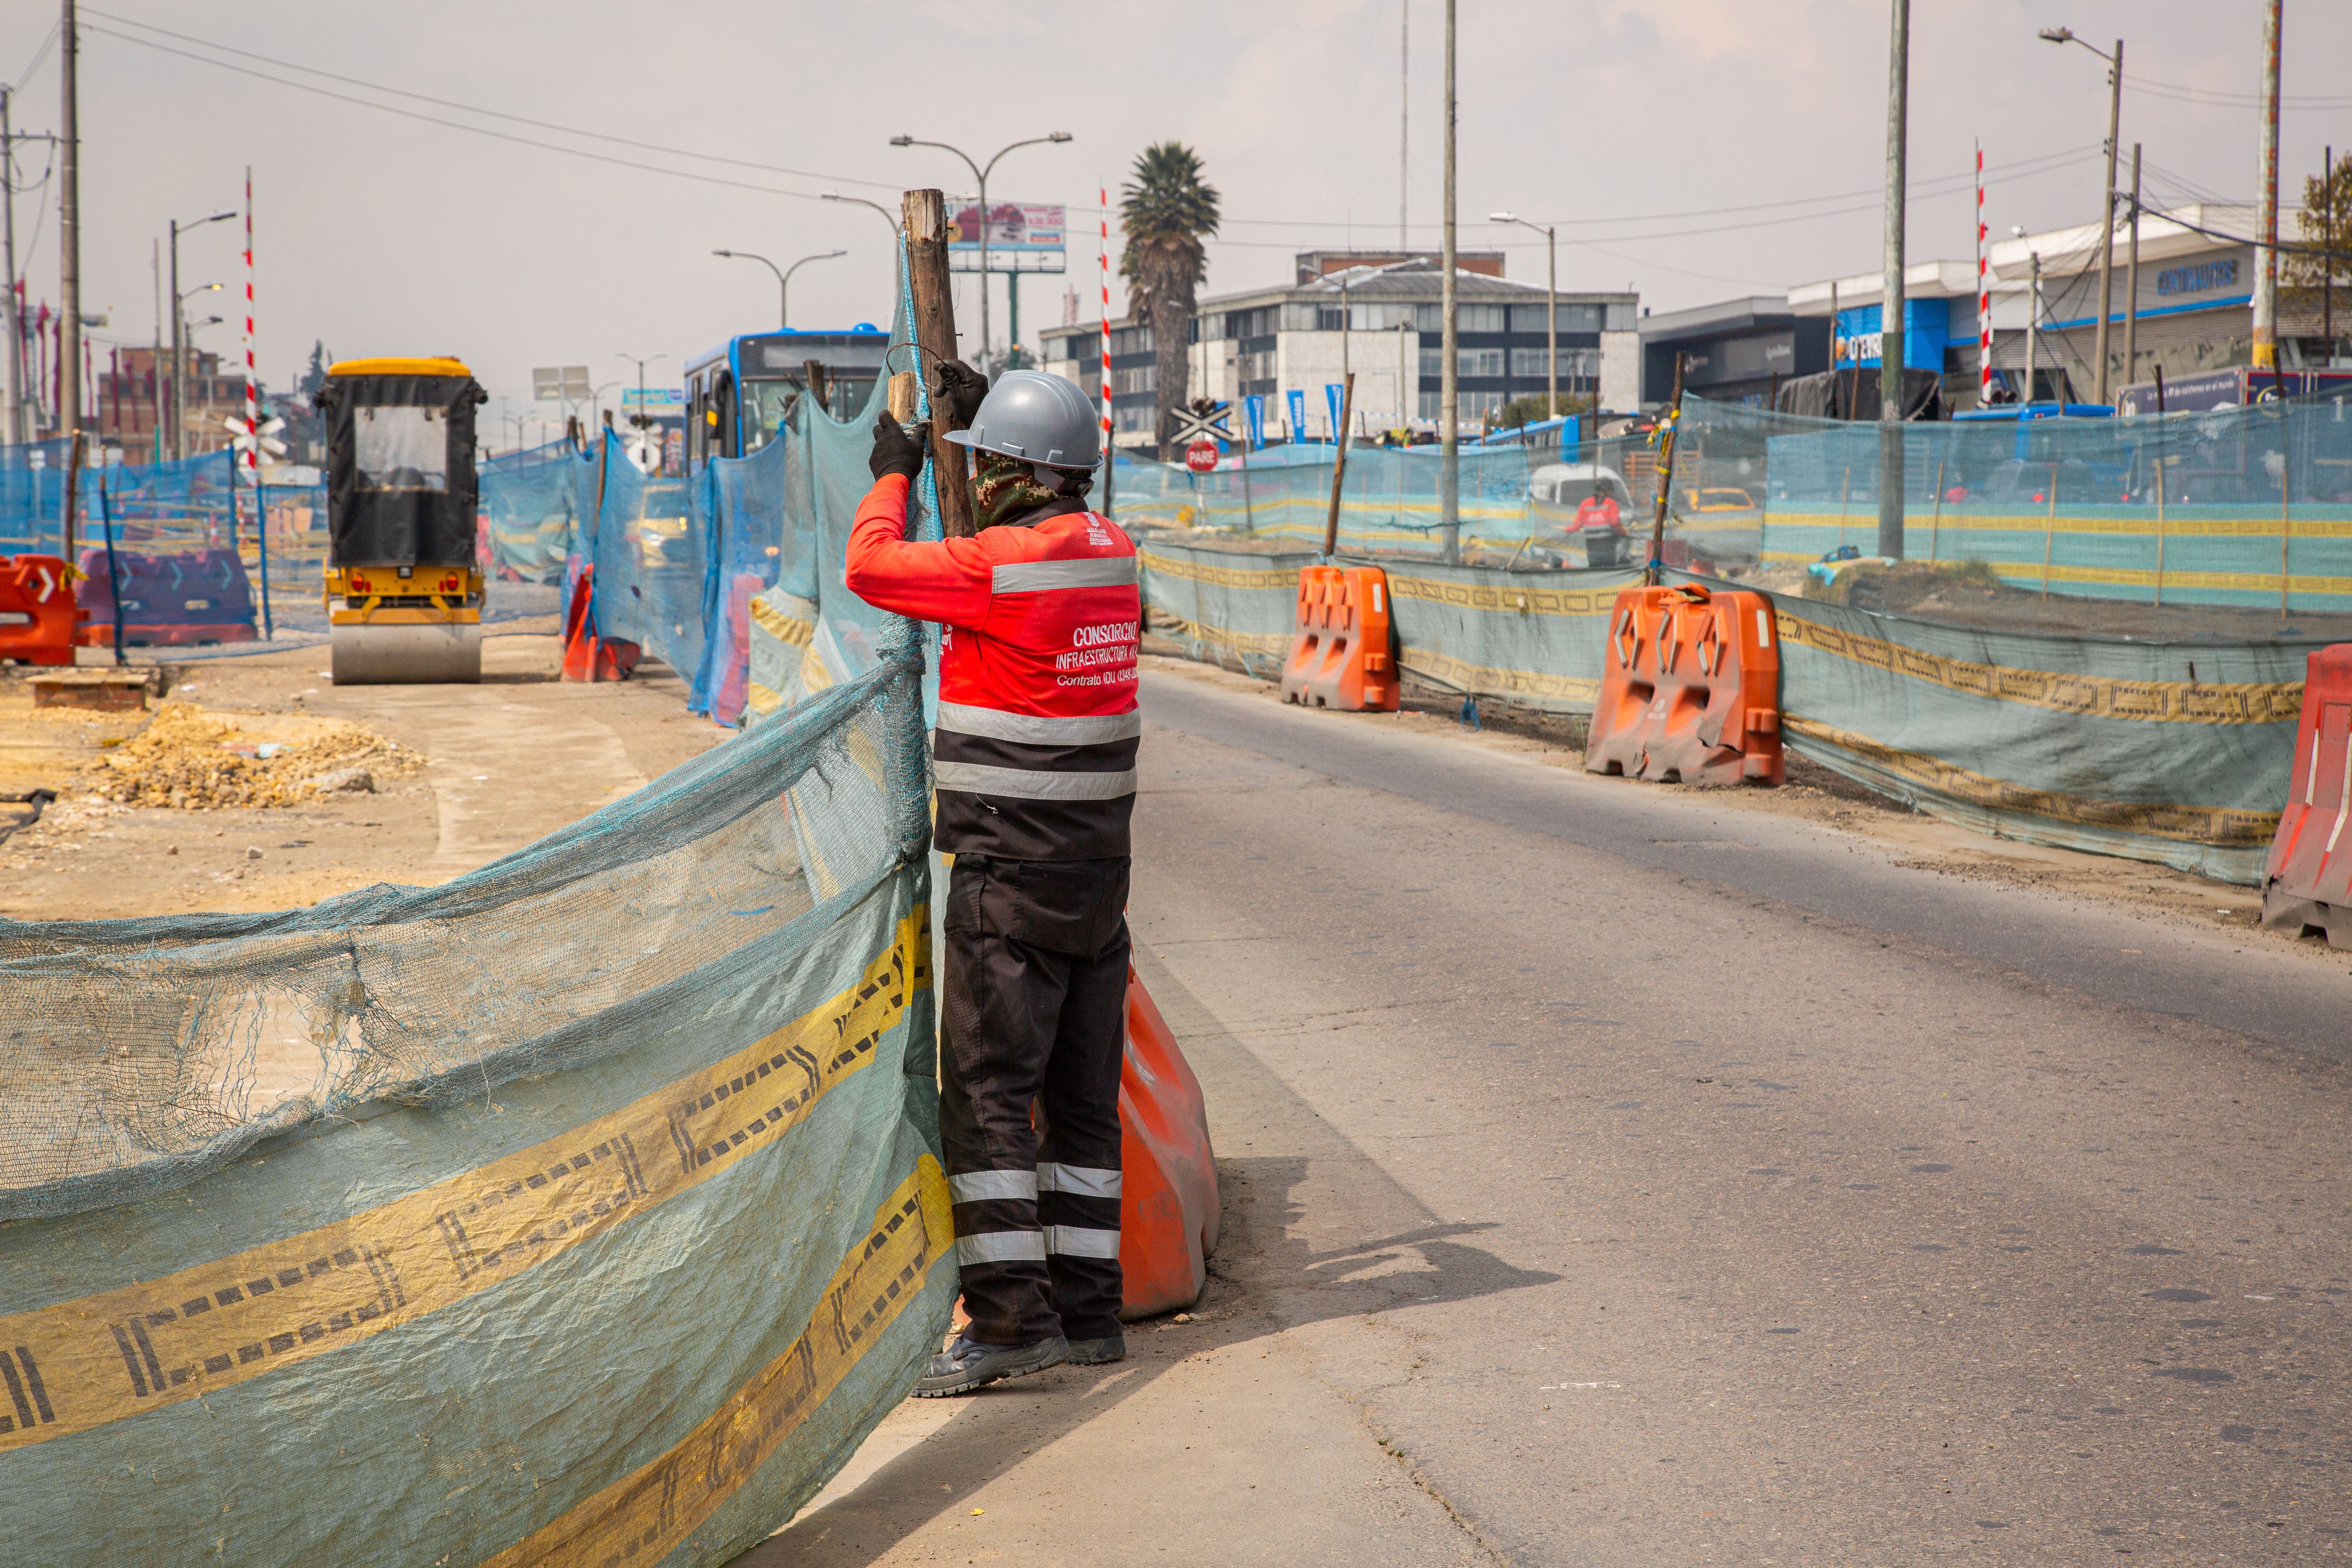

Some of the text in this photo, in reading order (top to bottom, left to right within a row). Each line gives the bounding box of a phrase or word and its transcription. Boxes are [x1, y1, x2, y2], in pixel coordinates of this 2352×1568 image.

[2157, 260, 2232, 295] CONTINAUTOS
[1189, 450, 1216, 464] PARE
[1074, 621, 1136, 647] CONSORCIO
[1056, 645, 1127, 669] INFRAESTRUCTURA
[1057, 675, 1101, 686] Contrato
[1103, 671, 1116, 684] IDU
